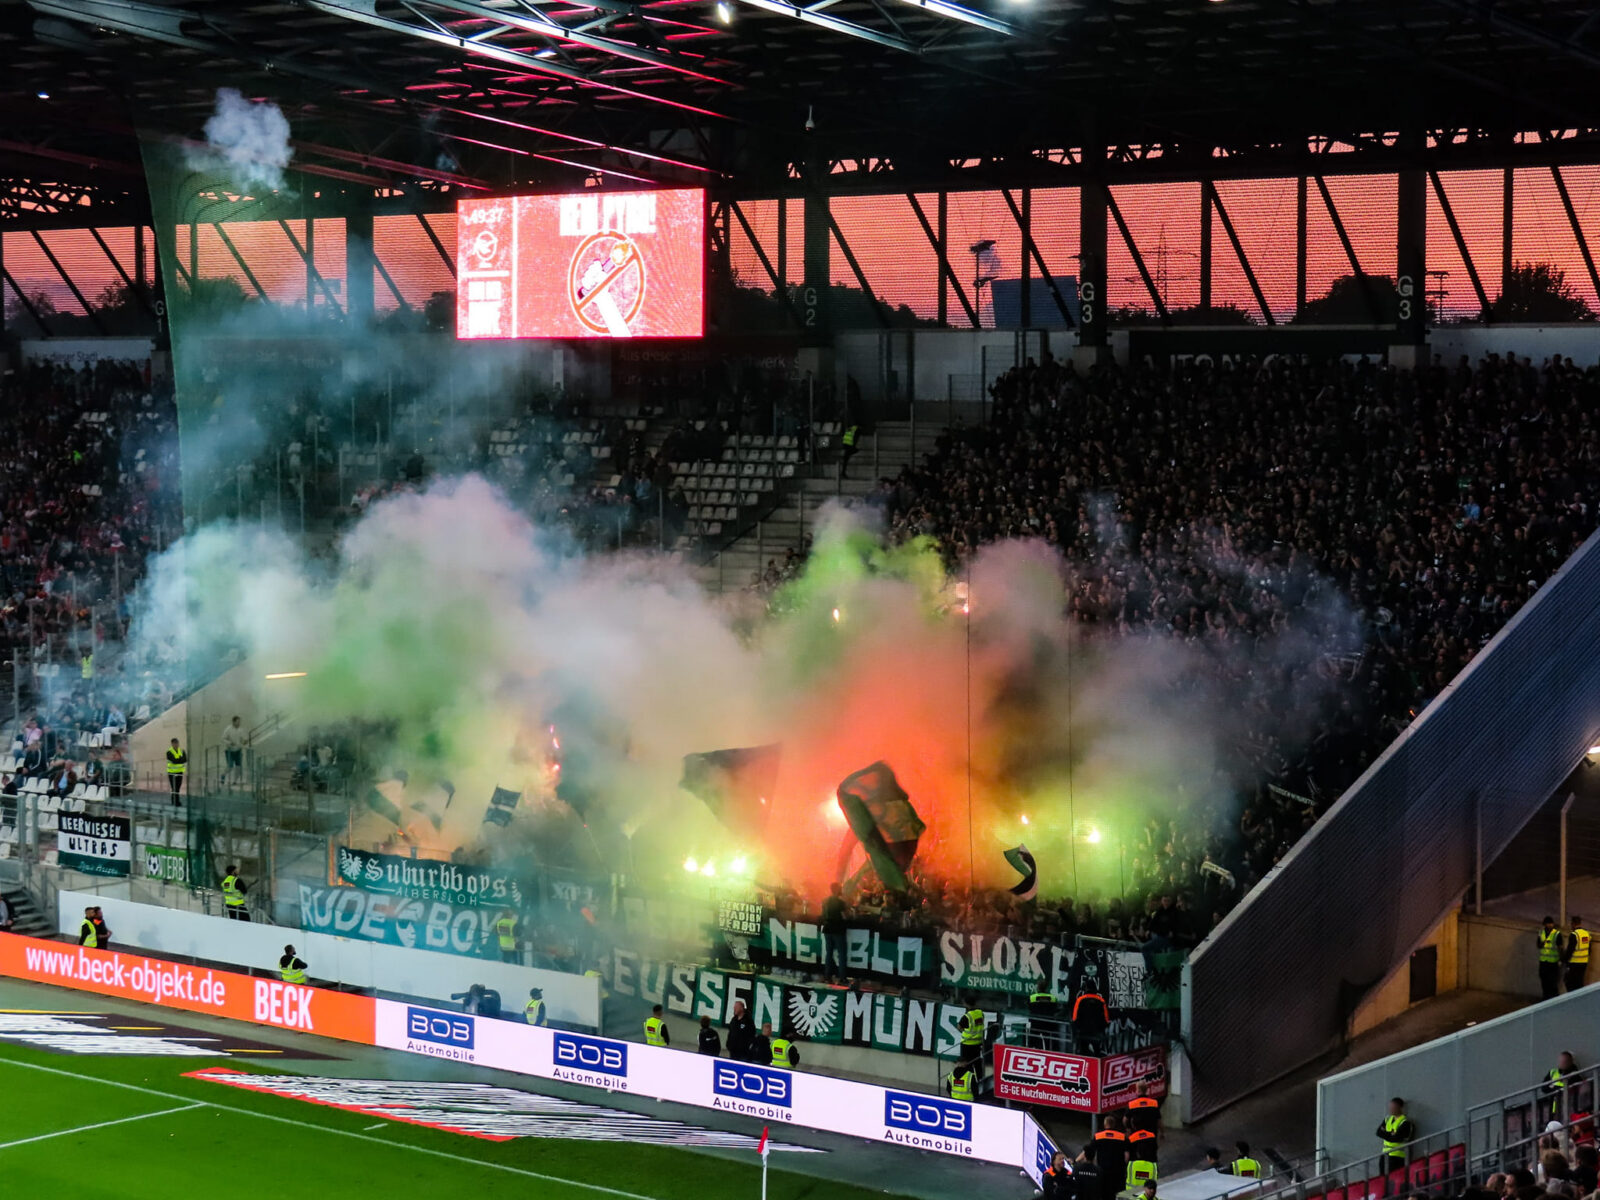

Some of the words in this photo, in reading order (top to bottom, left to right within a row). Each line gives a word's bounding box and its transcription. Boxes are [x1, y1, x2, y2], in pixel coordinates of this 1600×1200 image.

[69, 838, 118, 857] ULTRAS
[364, 857, 508, 898] Suburbboys
[395, 886, 478, 907] ALBERSLOH
[719, 901, 762, 914] SEKTION
[299, 884, 387, 939] RUDE
[425, 901, 520, 953] BOY
[940, 930, 1076, 1003] SLOKE
[1108, 964, 1145, 981] BESTEN
[26, 946, 226, 1006] www.beck-objekt.de
[255, 980, 315, 1029] BECK
[598, 947, 782, 1034] EUSSEN
[967, 975, 1022, 992] SPORTCLUB
[411, 1014, 470, 1041] BOB
[407, 1040, 475, 1062] Automobile
[558, 1040, 623, 1068] BOB
[553, 1067, 628, 1090] Automobile
[719, 1068, 787, 1099] BOB
[713, 1096, 792, 1121] Automobile
[1021, 1086, 1071, 1105] Nutzfahrzeuge
[1071, 1095, 1091, 1108] GmbH
[890, 1099, 966, 1132] BOB
[884, 1129, 973, 1155] Automobile
